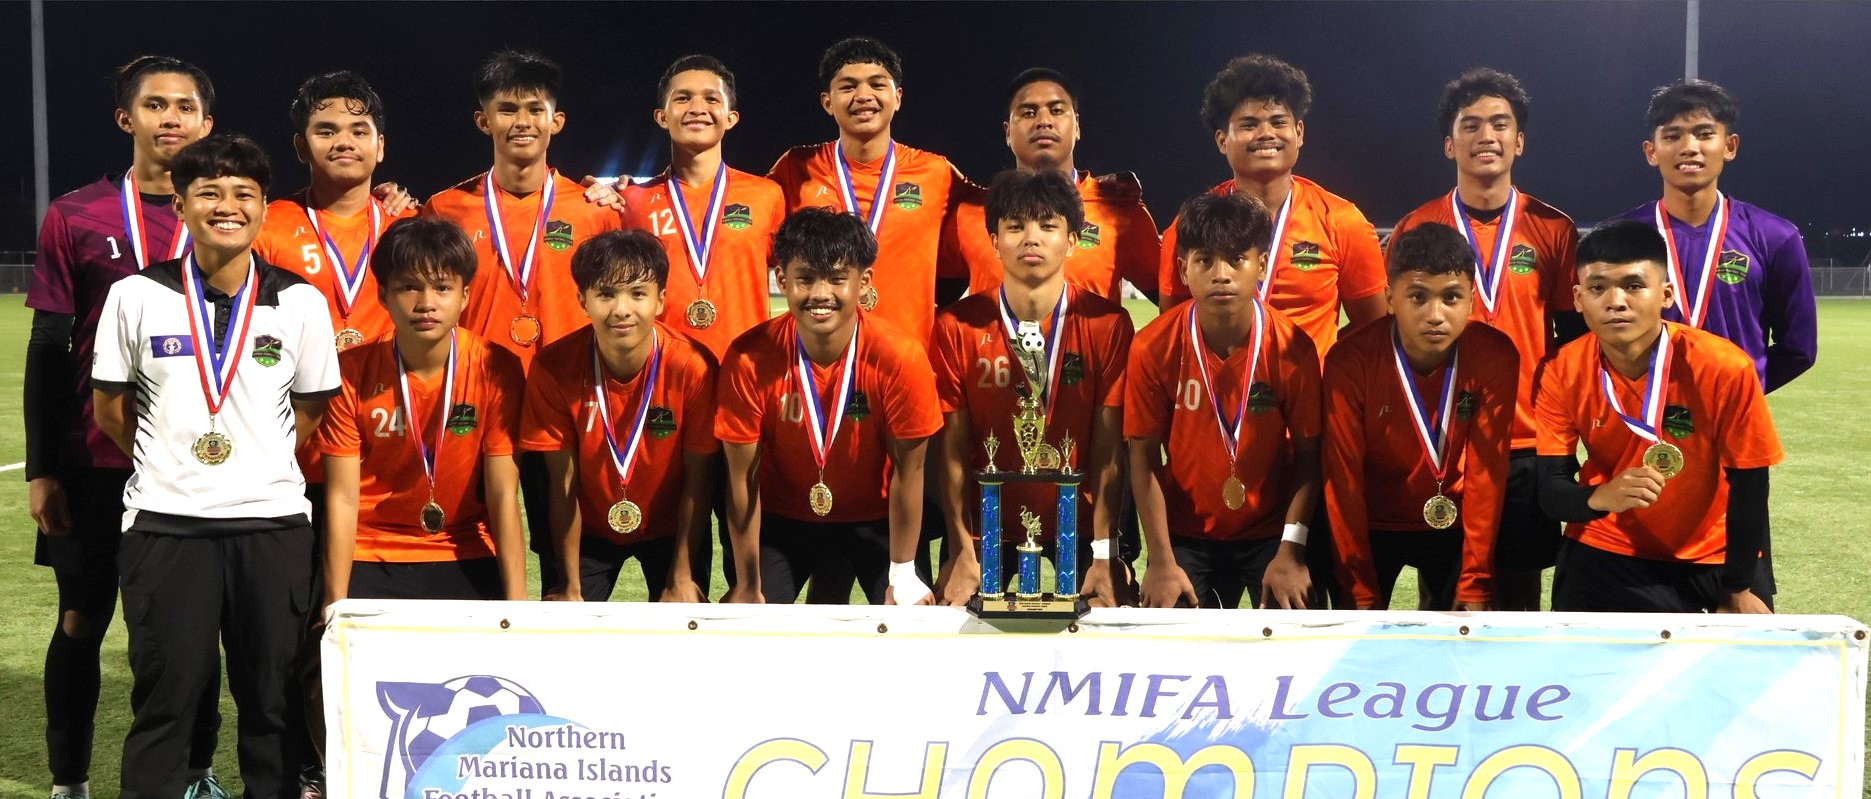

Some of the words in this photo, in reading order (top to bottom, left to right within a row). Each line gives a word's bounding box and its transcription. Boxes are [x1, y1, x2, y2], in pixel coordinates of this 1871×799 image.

[648, 207, 677, 237] 12
[106, 236, 122, 260] 1
[301, 243, 321, 275] 5
[975, 355, 1011, 388] 26
[370, 405, 408, 438] 24
[584, 400, 599, 433] 7
[780, 391, 804, 423] 10
[975, 671, 1235, 720] NMIFA
[1268, 675, 1572, 732] League
[507, 725, 626, 750] Northern
[458, 756, 568, 780] Mariana
[577, 758, 672, 783] Islands
